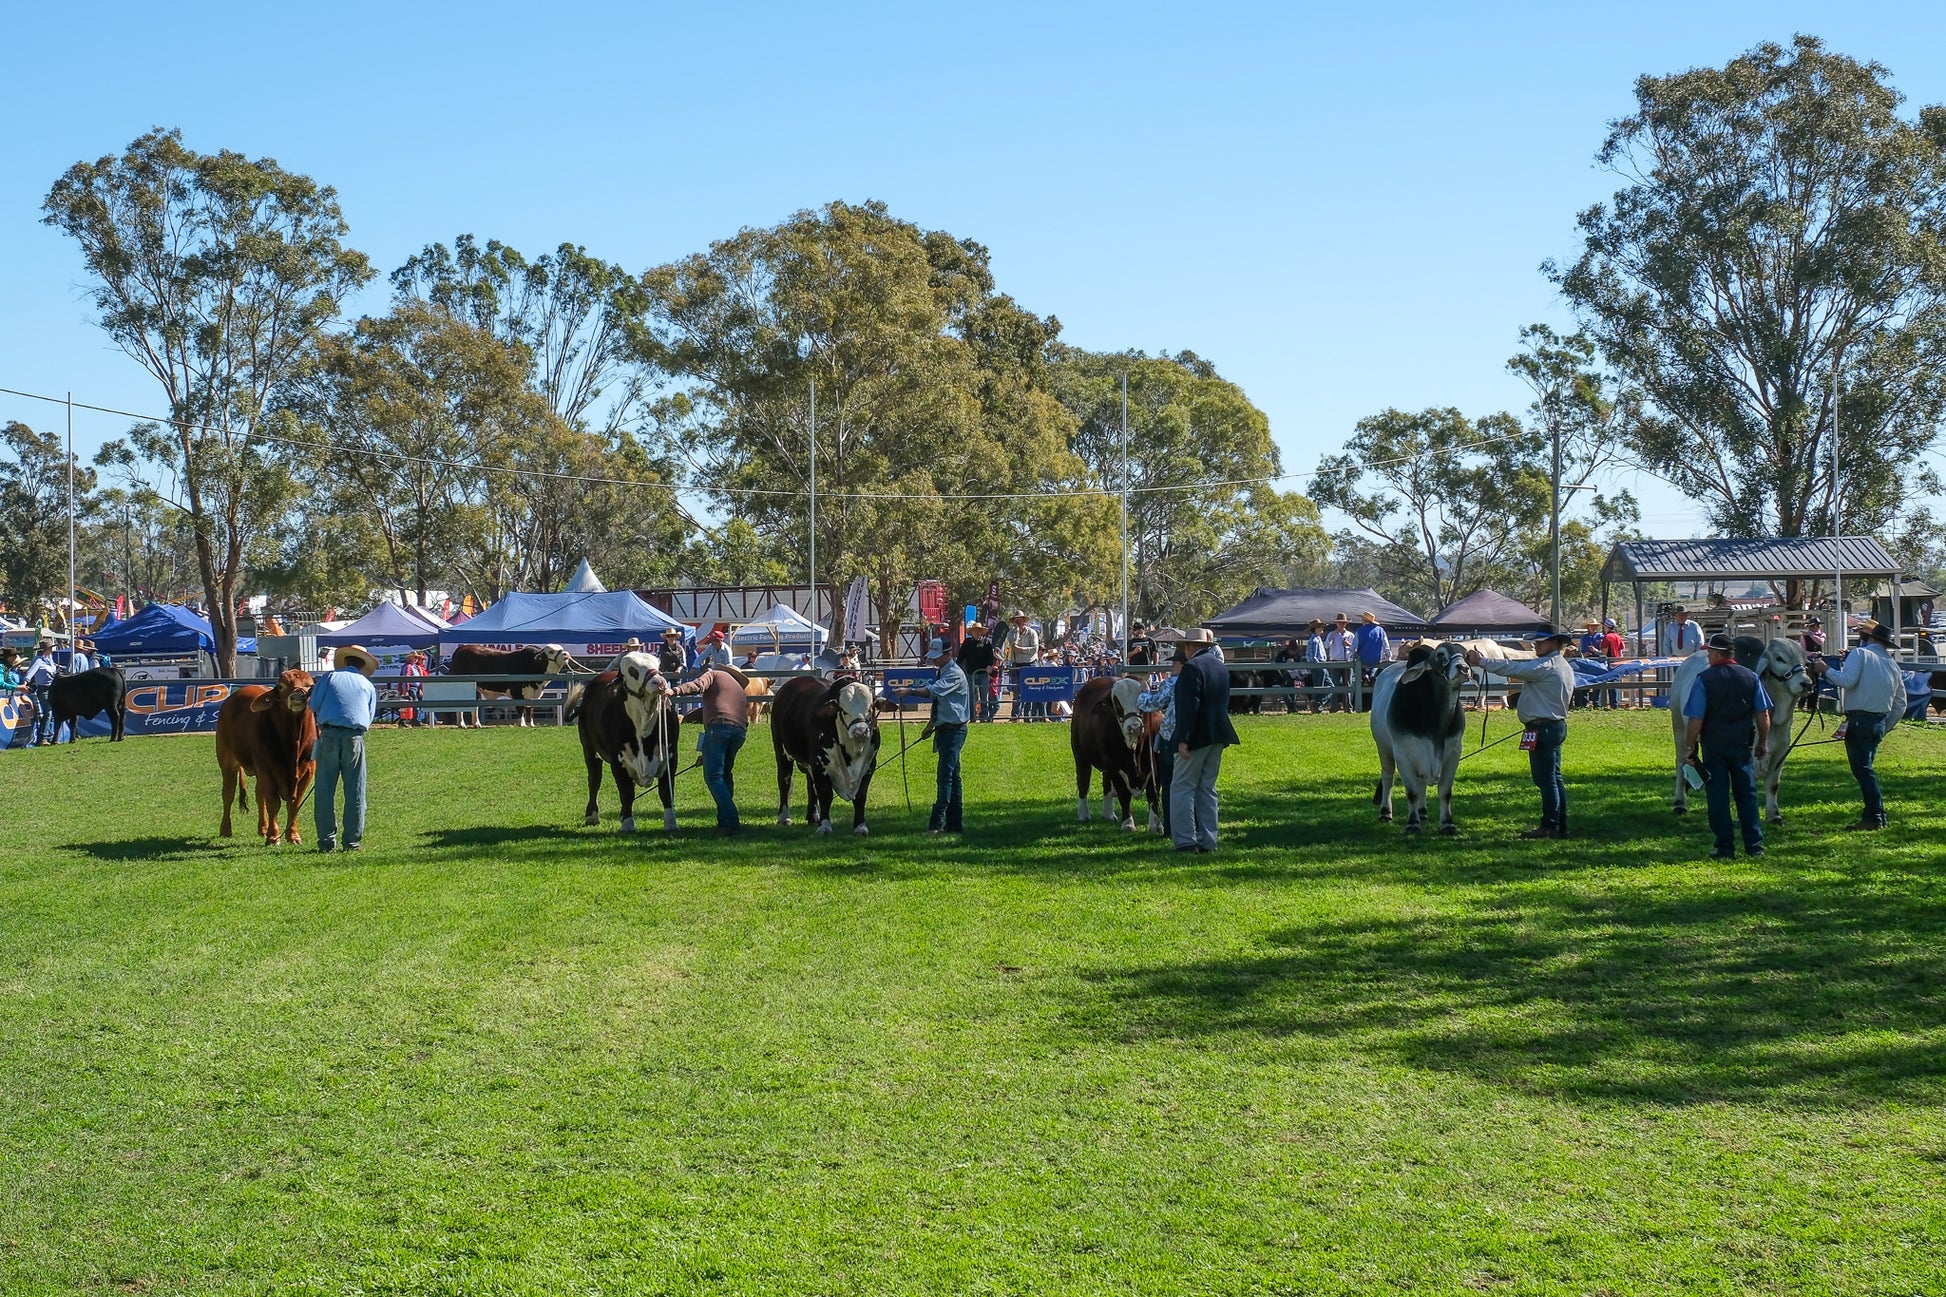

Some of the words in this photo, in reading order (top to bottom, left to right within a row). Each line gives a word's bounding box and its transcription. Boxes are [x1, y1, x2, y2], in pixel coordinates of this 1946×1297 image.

[735, 634, 759, 642] Electric
[125, 684, 240, 715] CLIP
[145, 713, 191, 731] Fencing
[195, 711, 206, 727] &
[1523, 732, 1536, 742] 033
